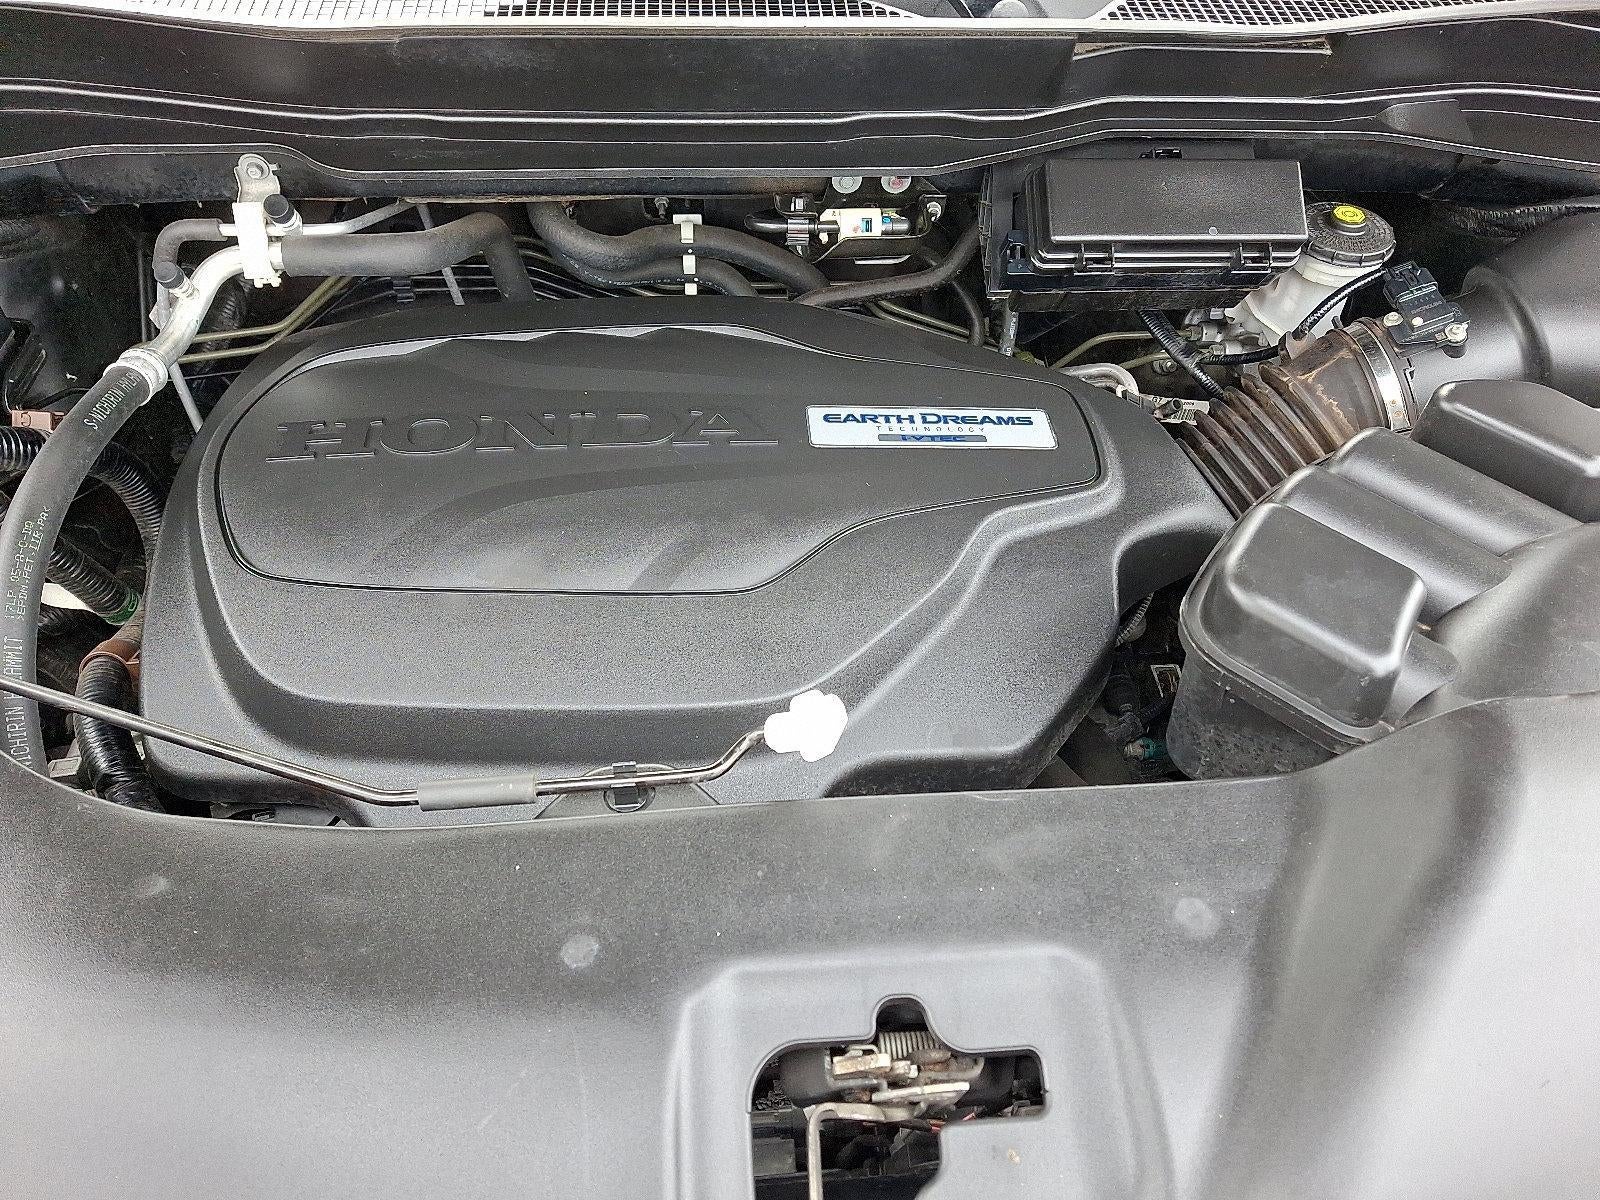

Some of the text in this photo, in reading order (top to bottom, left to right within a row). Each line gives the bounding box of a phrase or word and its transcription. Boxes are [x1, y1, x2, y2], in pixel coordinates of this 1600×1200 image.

[823, 412, 1034, 426] EARTH DREAMS
[265, 410, 778, 462] HONDA
